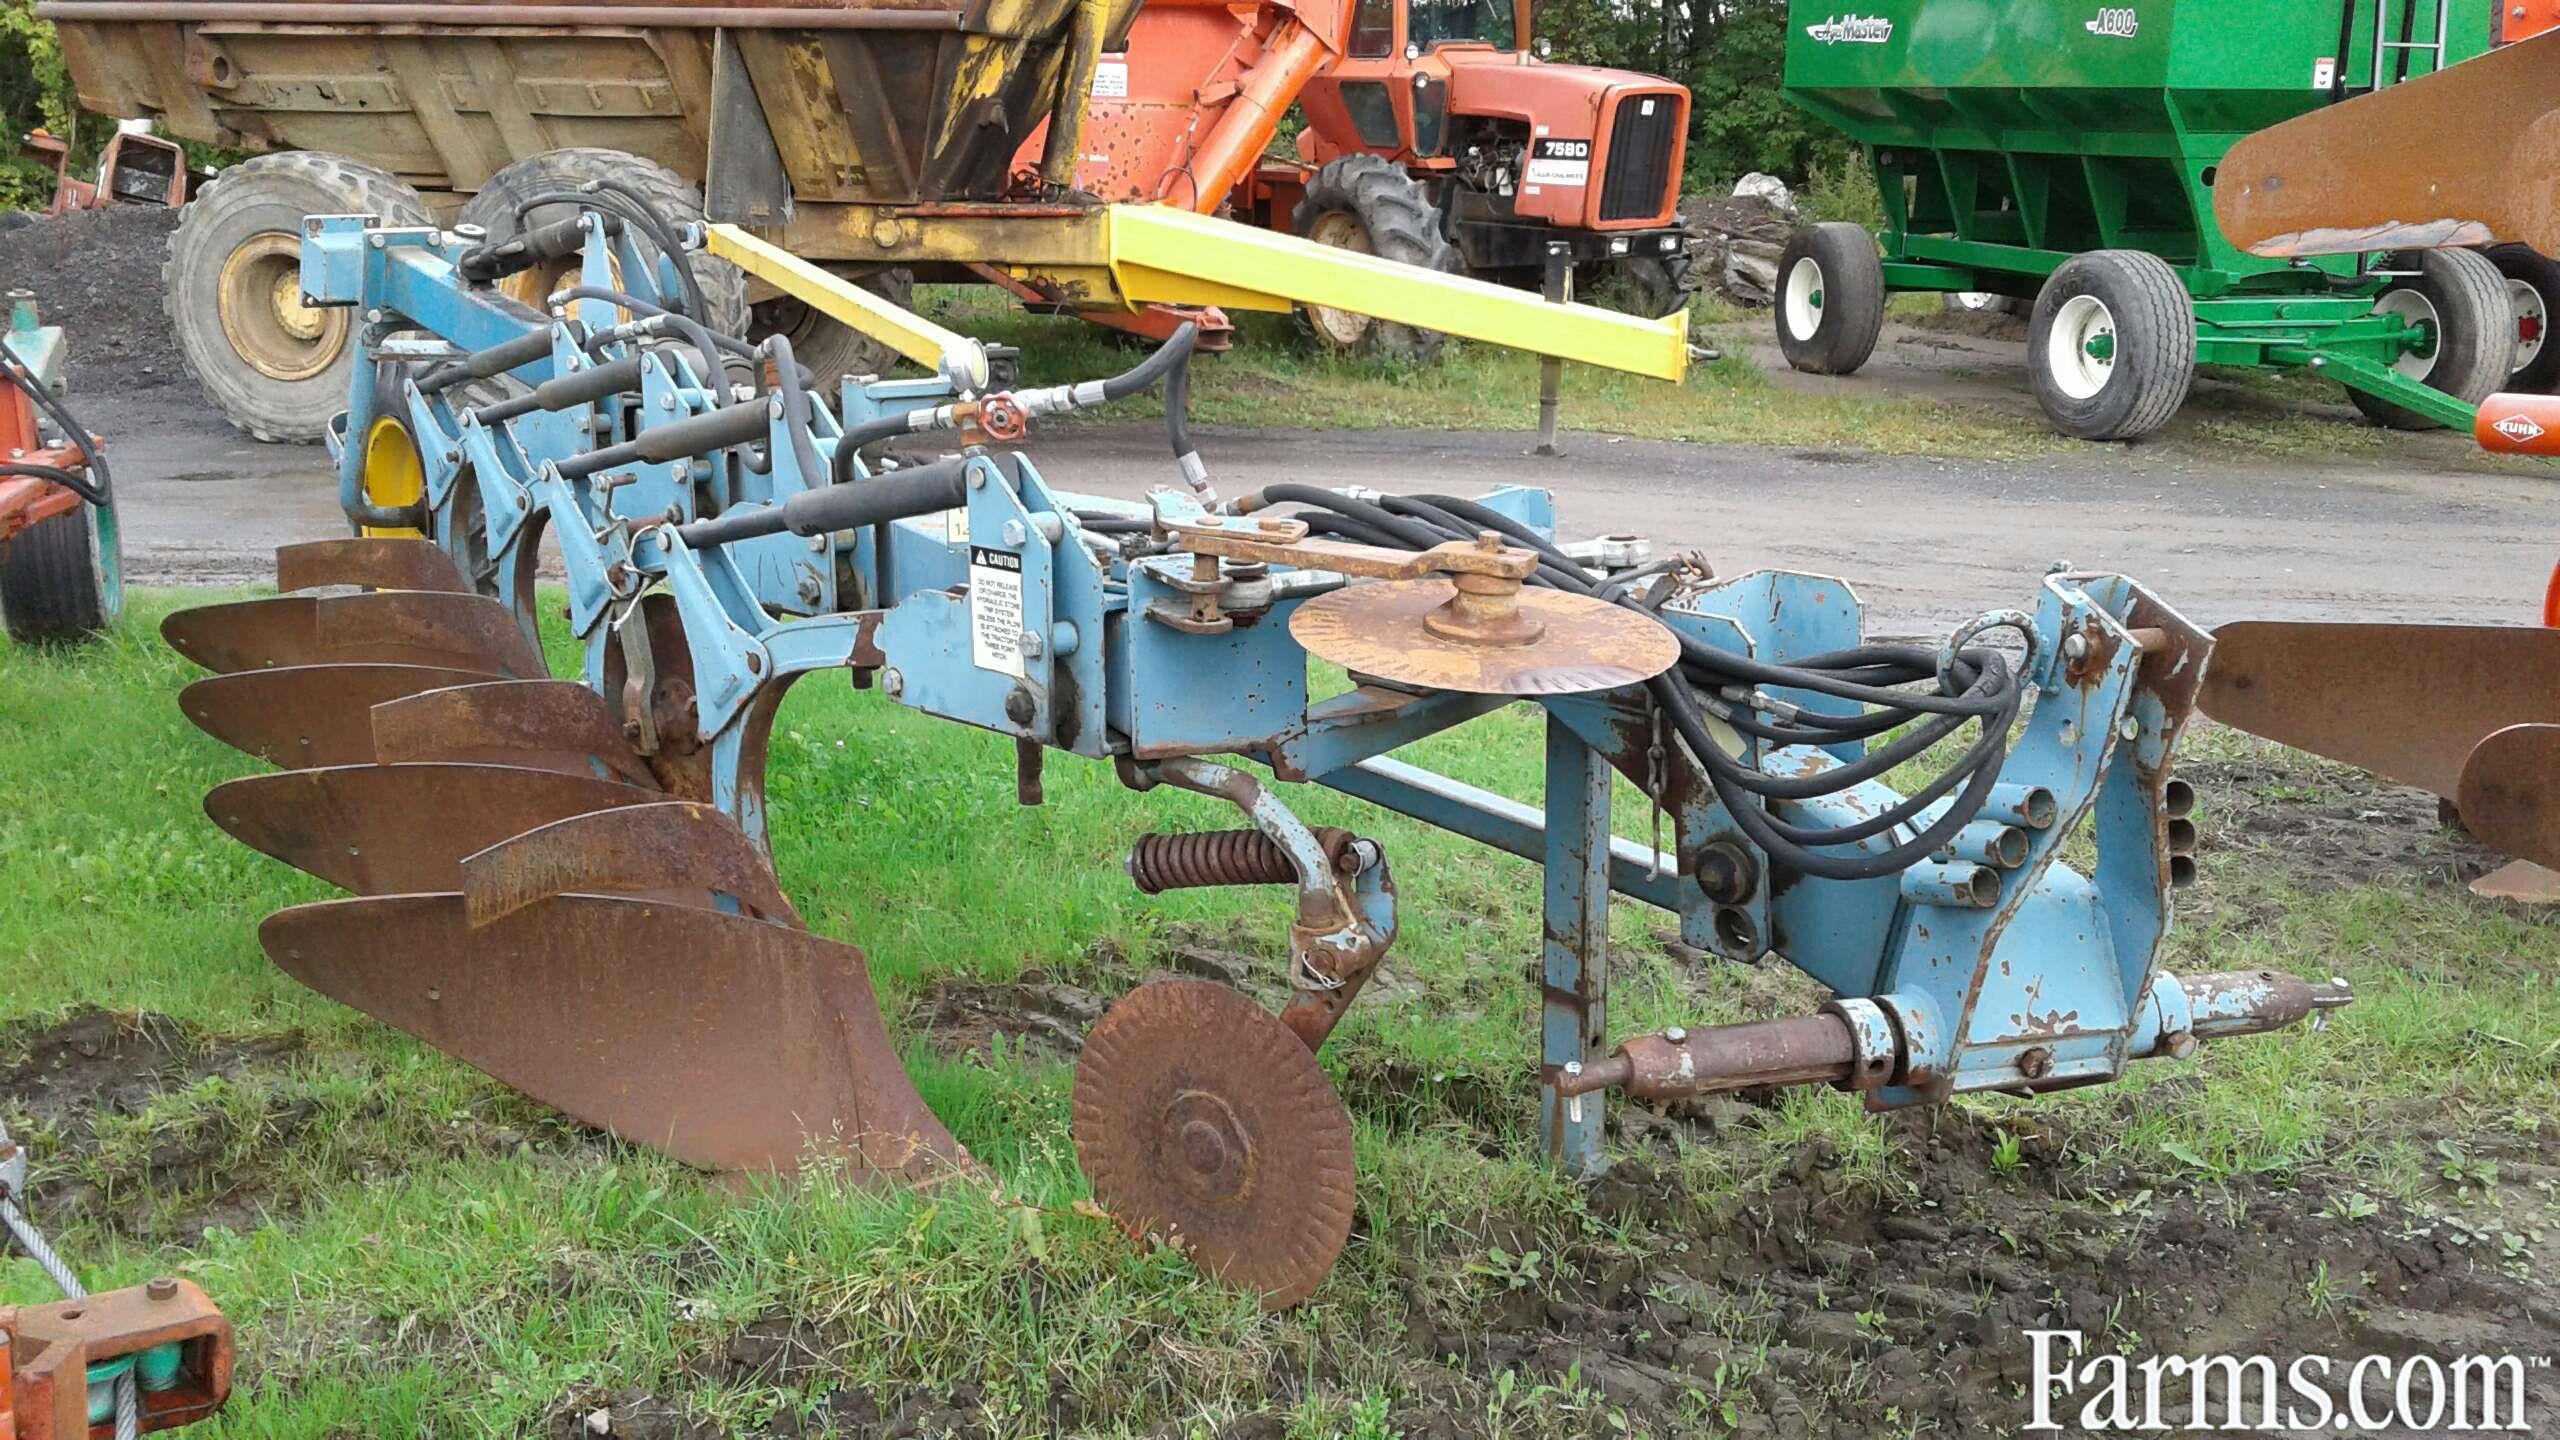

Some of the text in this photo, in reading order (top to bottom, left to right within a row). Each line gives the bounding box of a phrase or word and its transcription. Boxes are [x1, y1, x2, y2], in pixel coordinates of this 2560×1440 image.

[2096, 8, 2134, 34] A600
[1545, 142, 1587, 156] 7580
[2499, 421, 2537, 435] KUHN
[989, 552, 1019, 568] CAUTION
